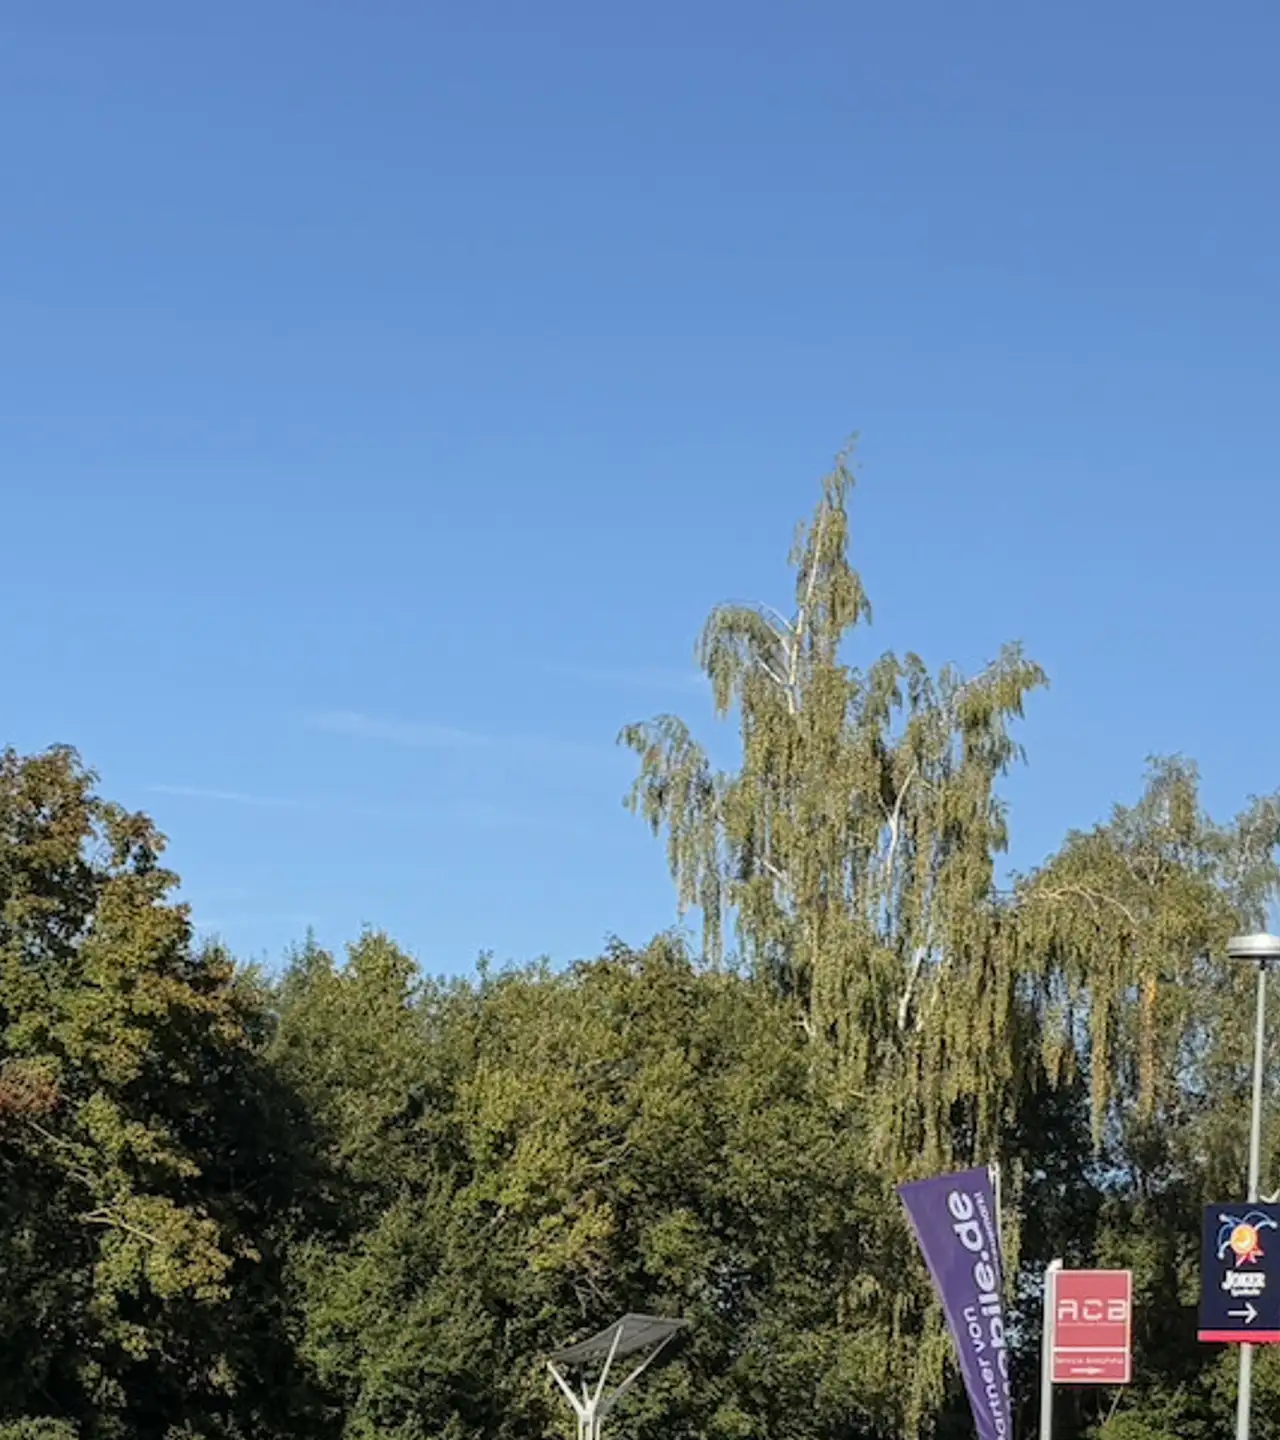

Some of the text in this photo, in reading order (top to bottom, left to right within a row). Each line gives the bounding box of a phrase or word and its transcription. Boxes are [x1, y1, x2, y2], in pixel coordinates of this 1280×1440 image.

[948, 1190, 1011, 1418] bile.de
[1221, 1271, 1267, 1291] JOKER
[963, 1306, 987, 1353] von
